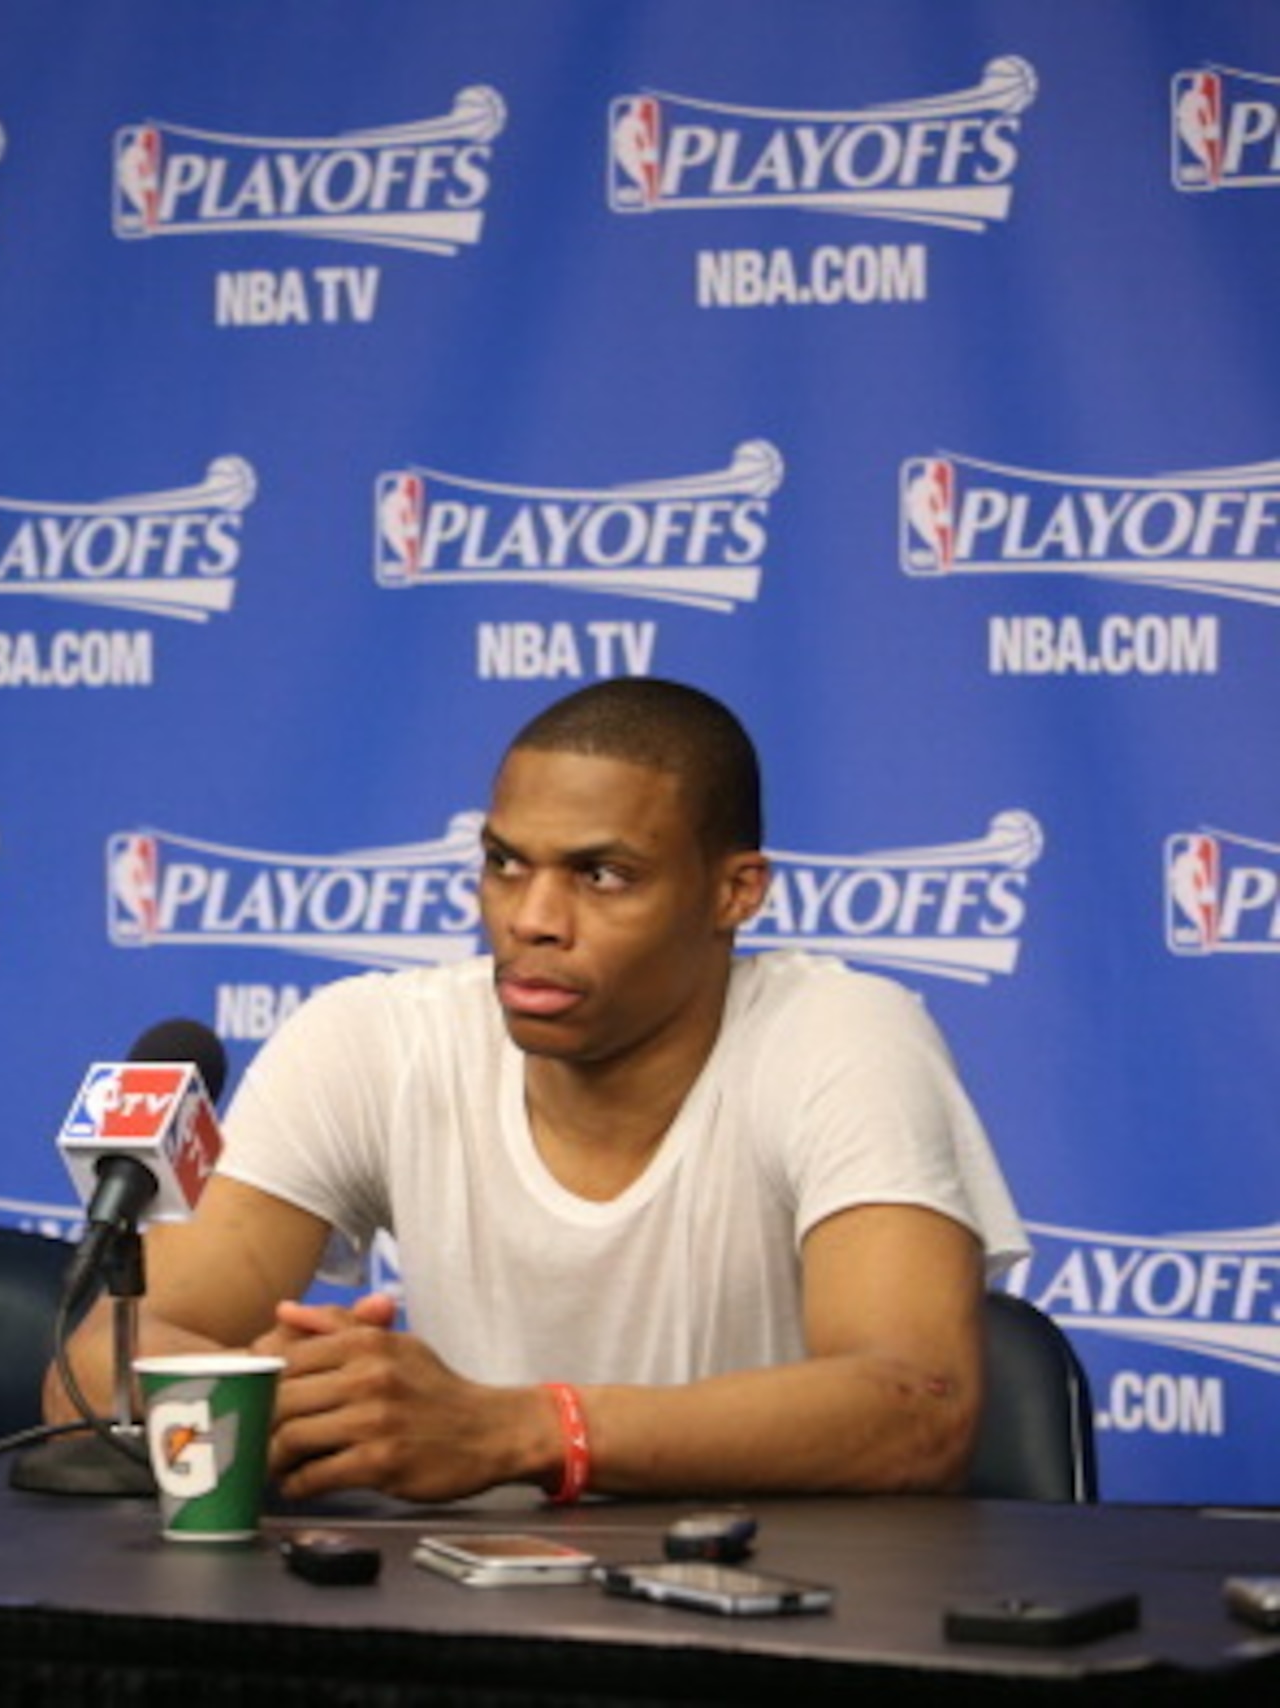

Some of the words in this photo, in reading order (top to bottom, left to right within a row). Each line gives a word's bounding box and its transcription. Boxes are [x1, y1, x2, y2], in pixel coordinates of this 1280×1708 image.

[661, 118, 1021, 195] PLAYOFFS
[1221, 101, 1280, 173] P
[158, 145, 491, 221] PLAYOFFS
[215, 269, 310, 327] NBA
[314, 266, 380, 322] TV
[696, 243, 927, 308] NBA.COM
[422, 500, 769, 568] PLAYOFFS
[953, 490, 1280, 560] PLAYOFF
[477, 621, 582, 679] NBA
[586, 621, 656, 678] TV
[988, 614, 1220, 675] NBA.COM
[157, 863, 482, 932] PLAYOFFS
[738, 868, 1028, 936] AYOFFS
[1219, 868, 1280, 938] P
[149, 1399, 218, 1498] G
